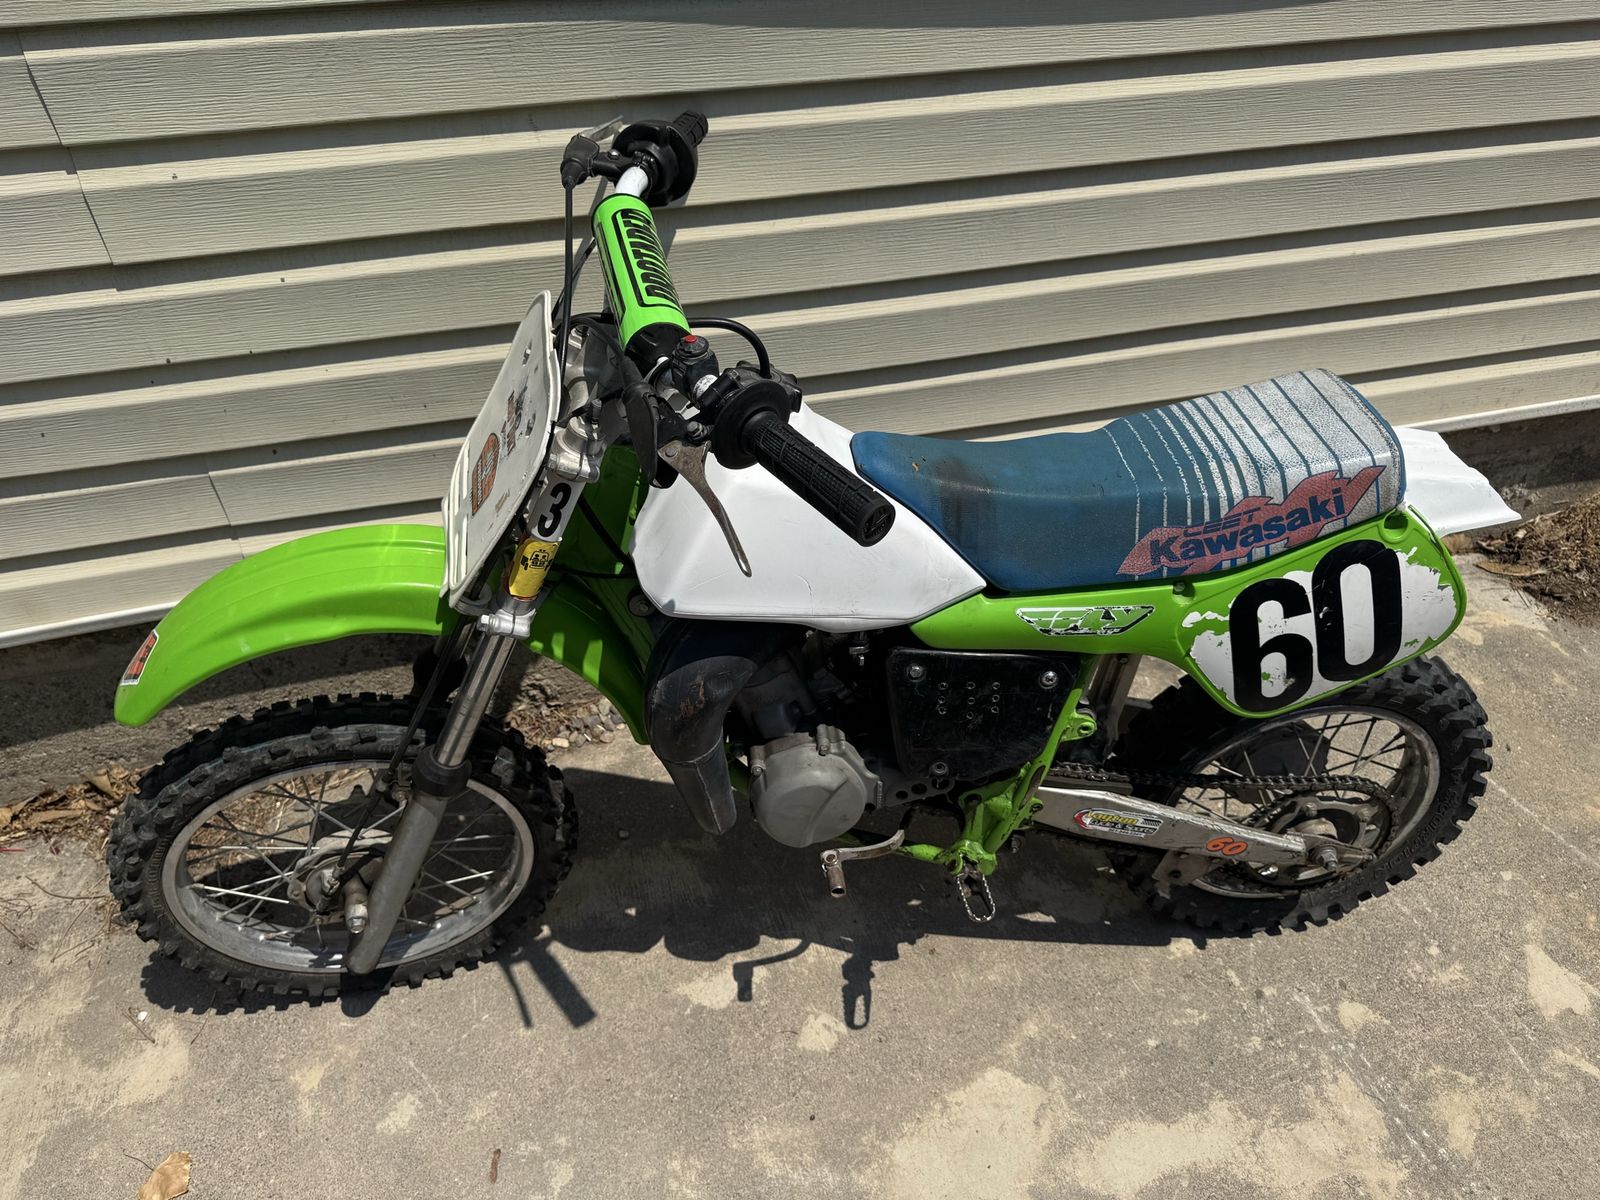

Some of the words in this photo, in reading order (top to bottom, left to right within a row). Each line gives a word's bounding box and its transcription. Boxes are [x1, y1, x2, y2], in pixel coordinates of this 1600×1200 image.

[537, 482, 572, 538] 3
[1150, 487, 1345, 566] Kawasaki
[1229, 539, 1402, 712] 60
[1206, 837, 1248, 856] 60
